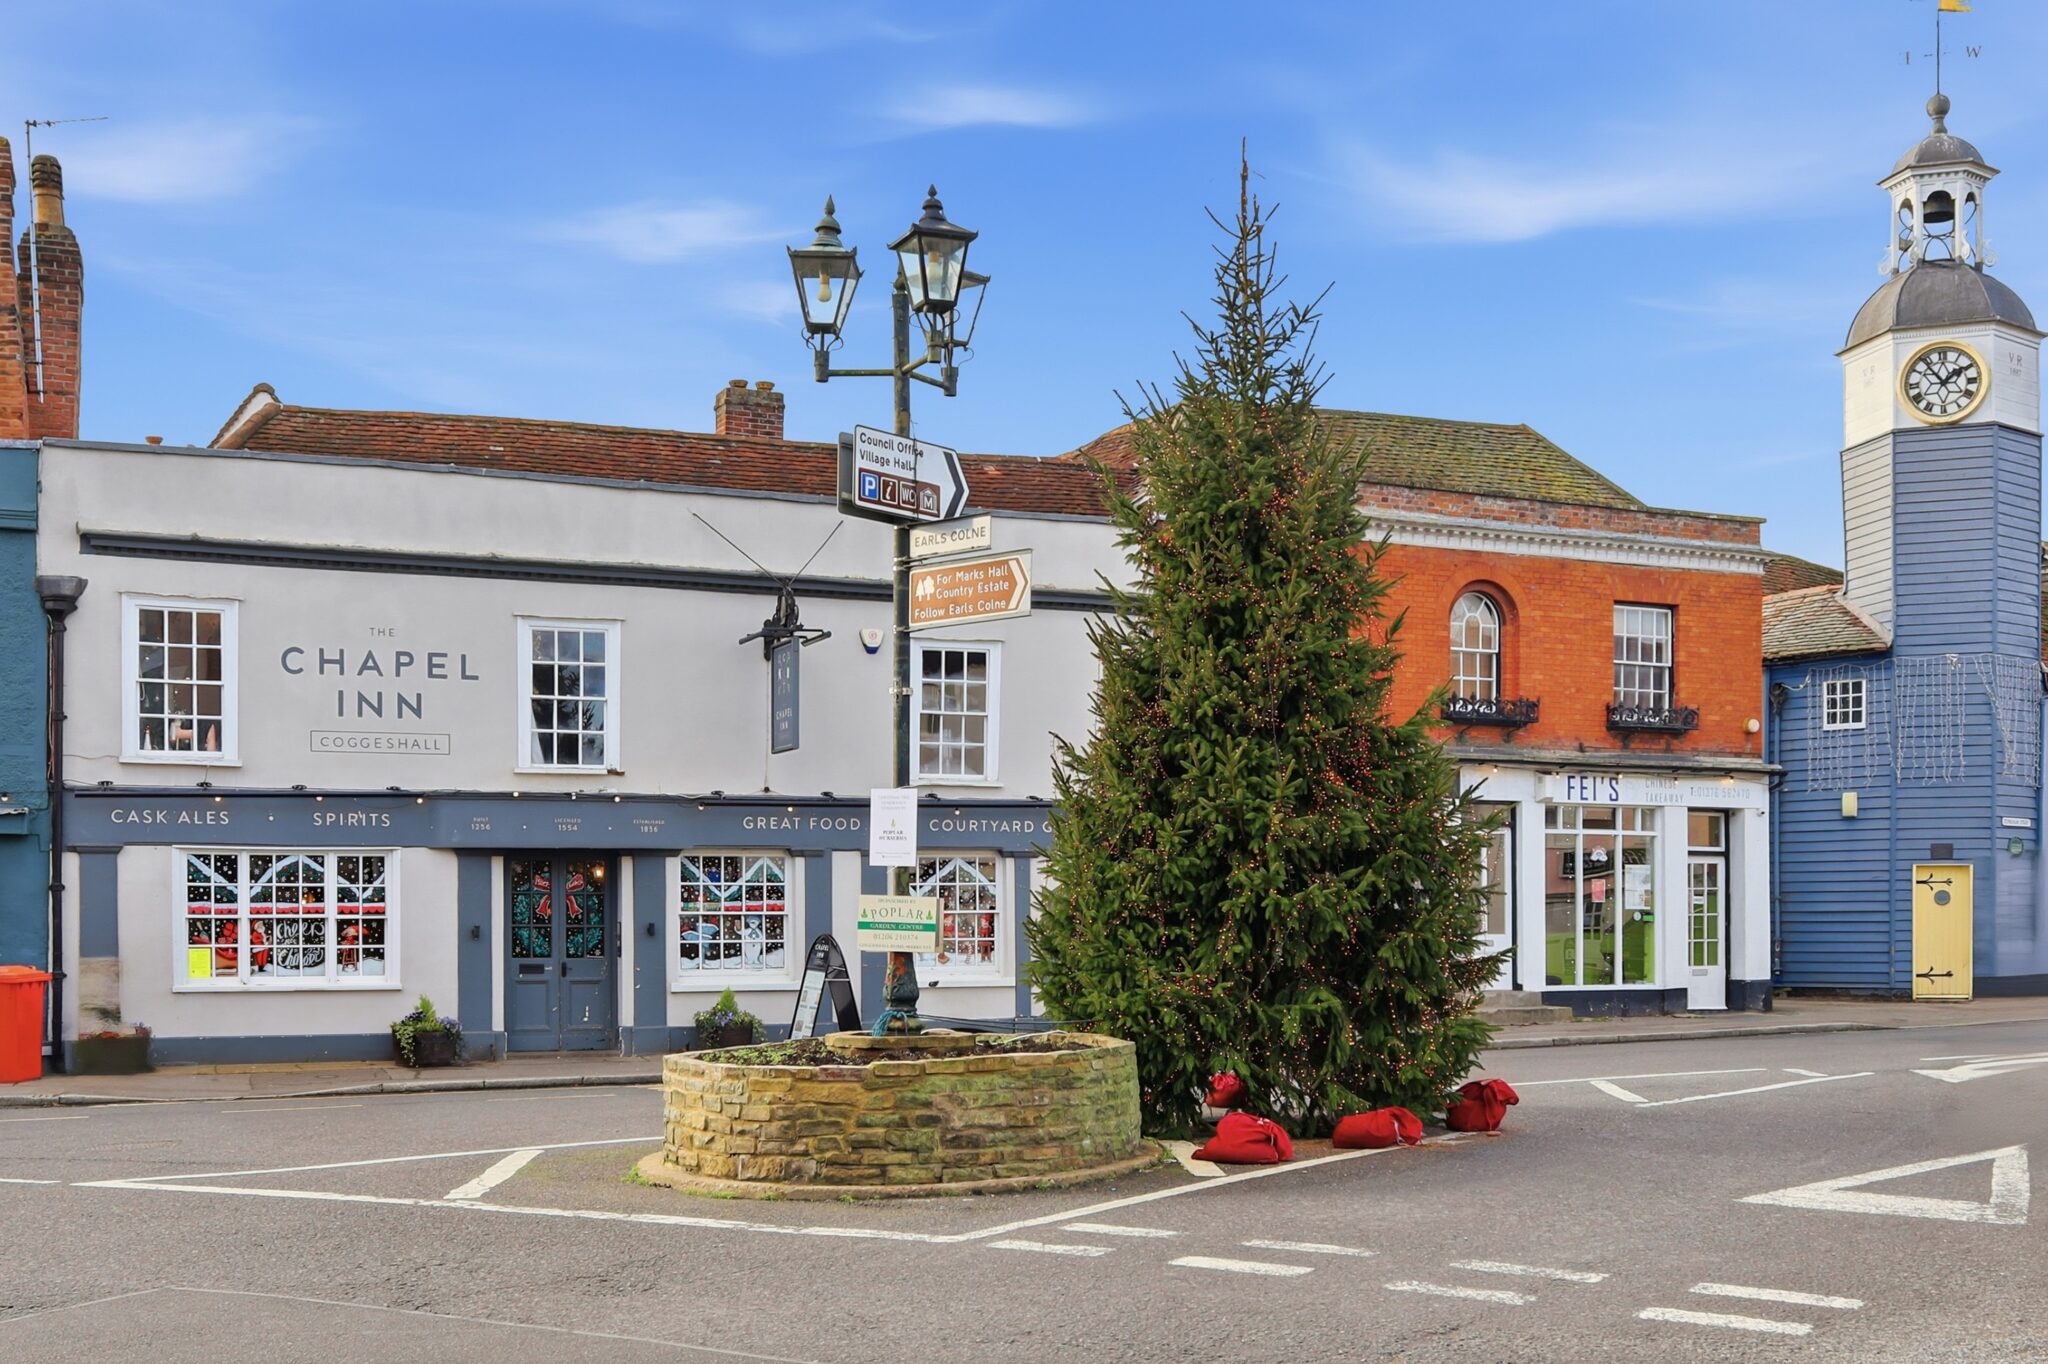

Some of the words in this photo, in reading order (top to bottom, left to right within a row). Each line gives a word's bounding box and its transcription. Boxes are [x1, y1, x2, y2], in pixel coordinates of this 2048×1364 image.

[860, 432, 894, 451] Council
[897, 441, 924, 458] Office
[859, 449, 890, 467] Village
[894, 457, 912, 471] Hall
[901, 487, 916, 502] WC
[914, 532, 947, 548] EARLS
[950, 526, 986, 542] COLNE
[936, 574, 952, 585] For
[956, 570, 984, 582] Marks
[988, 564, 1009, 577] Hall
[936, 586, 973, 600] Country
[977, 580, 1009, 593] Estate
[914, 608, 945, 619] Follow
[949, 602, 974, 615] Earls
[977, 599, 1006, 611] Colne
[369, 627, 395, 637] THE
[280, 646, 479, 681] CHAPEL
[337, 690, 422, 720] INN
[320, 736, 441, 750] COGGESHALL
[1567, 775, 1619, 802] FEI'S
[1645, 778, 1677, 790] CHINESE
[1645, 792, 1684, 803] TAKEAWAY
[111, 809, 168, 824] CASK
[177, 810, 229, 825] ALES
[313, 812, 391, 827] SPIRITS
[743, 816, 800, 830] GREAT
[809, 817, 861, 831] FOOD
[929, 819, 1034, 833] COURTYARD
[870, 907, 923, 920] POPLAR
